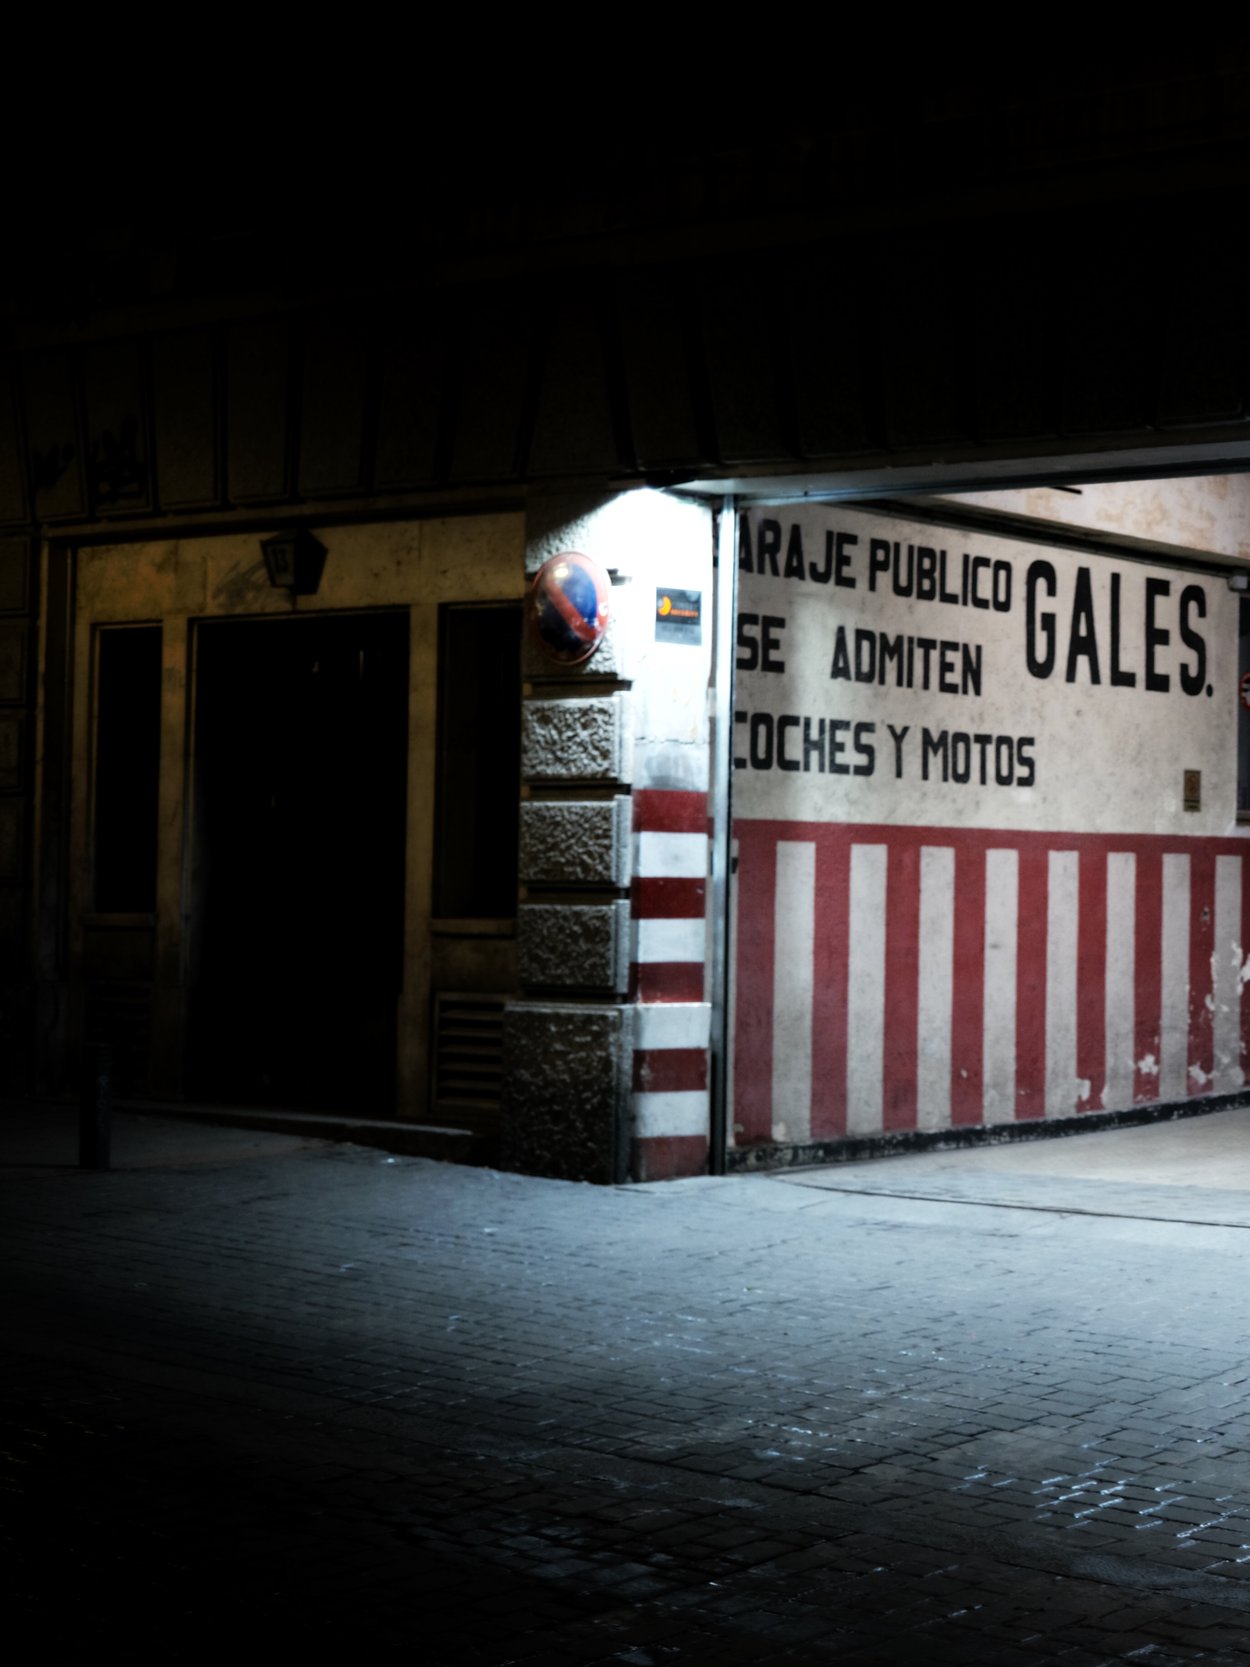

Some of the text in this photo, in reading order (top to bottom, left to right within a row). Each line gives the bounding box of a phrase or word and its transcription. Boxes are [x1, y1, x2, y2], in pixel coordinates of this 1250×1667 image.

[713, 510, 1213, 697] ARAJE PUBLICO GALES.
[737, 614, 982, 697] SE ADMITEN
[887, 725, 909, 778] Y
[922, 728, 1035, 787] MOTOS
